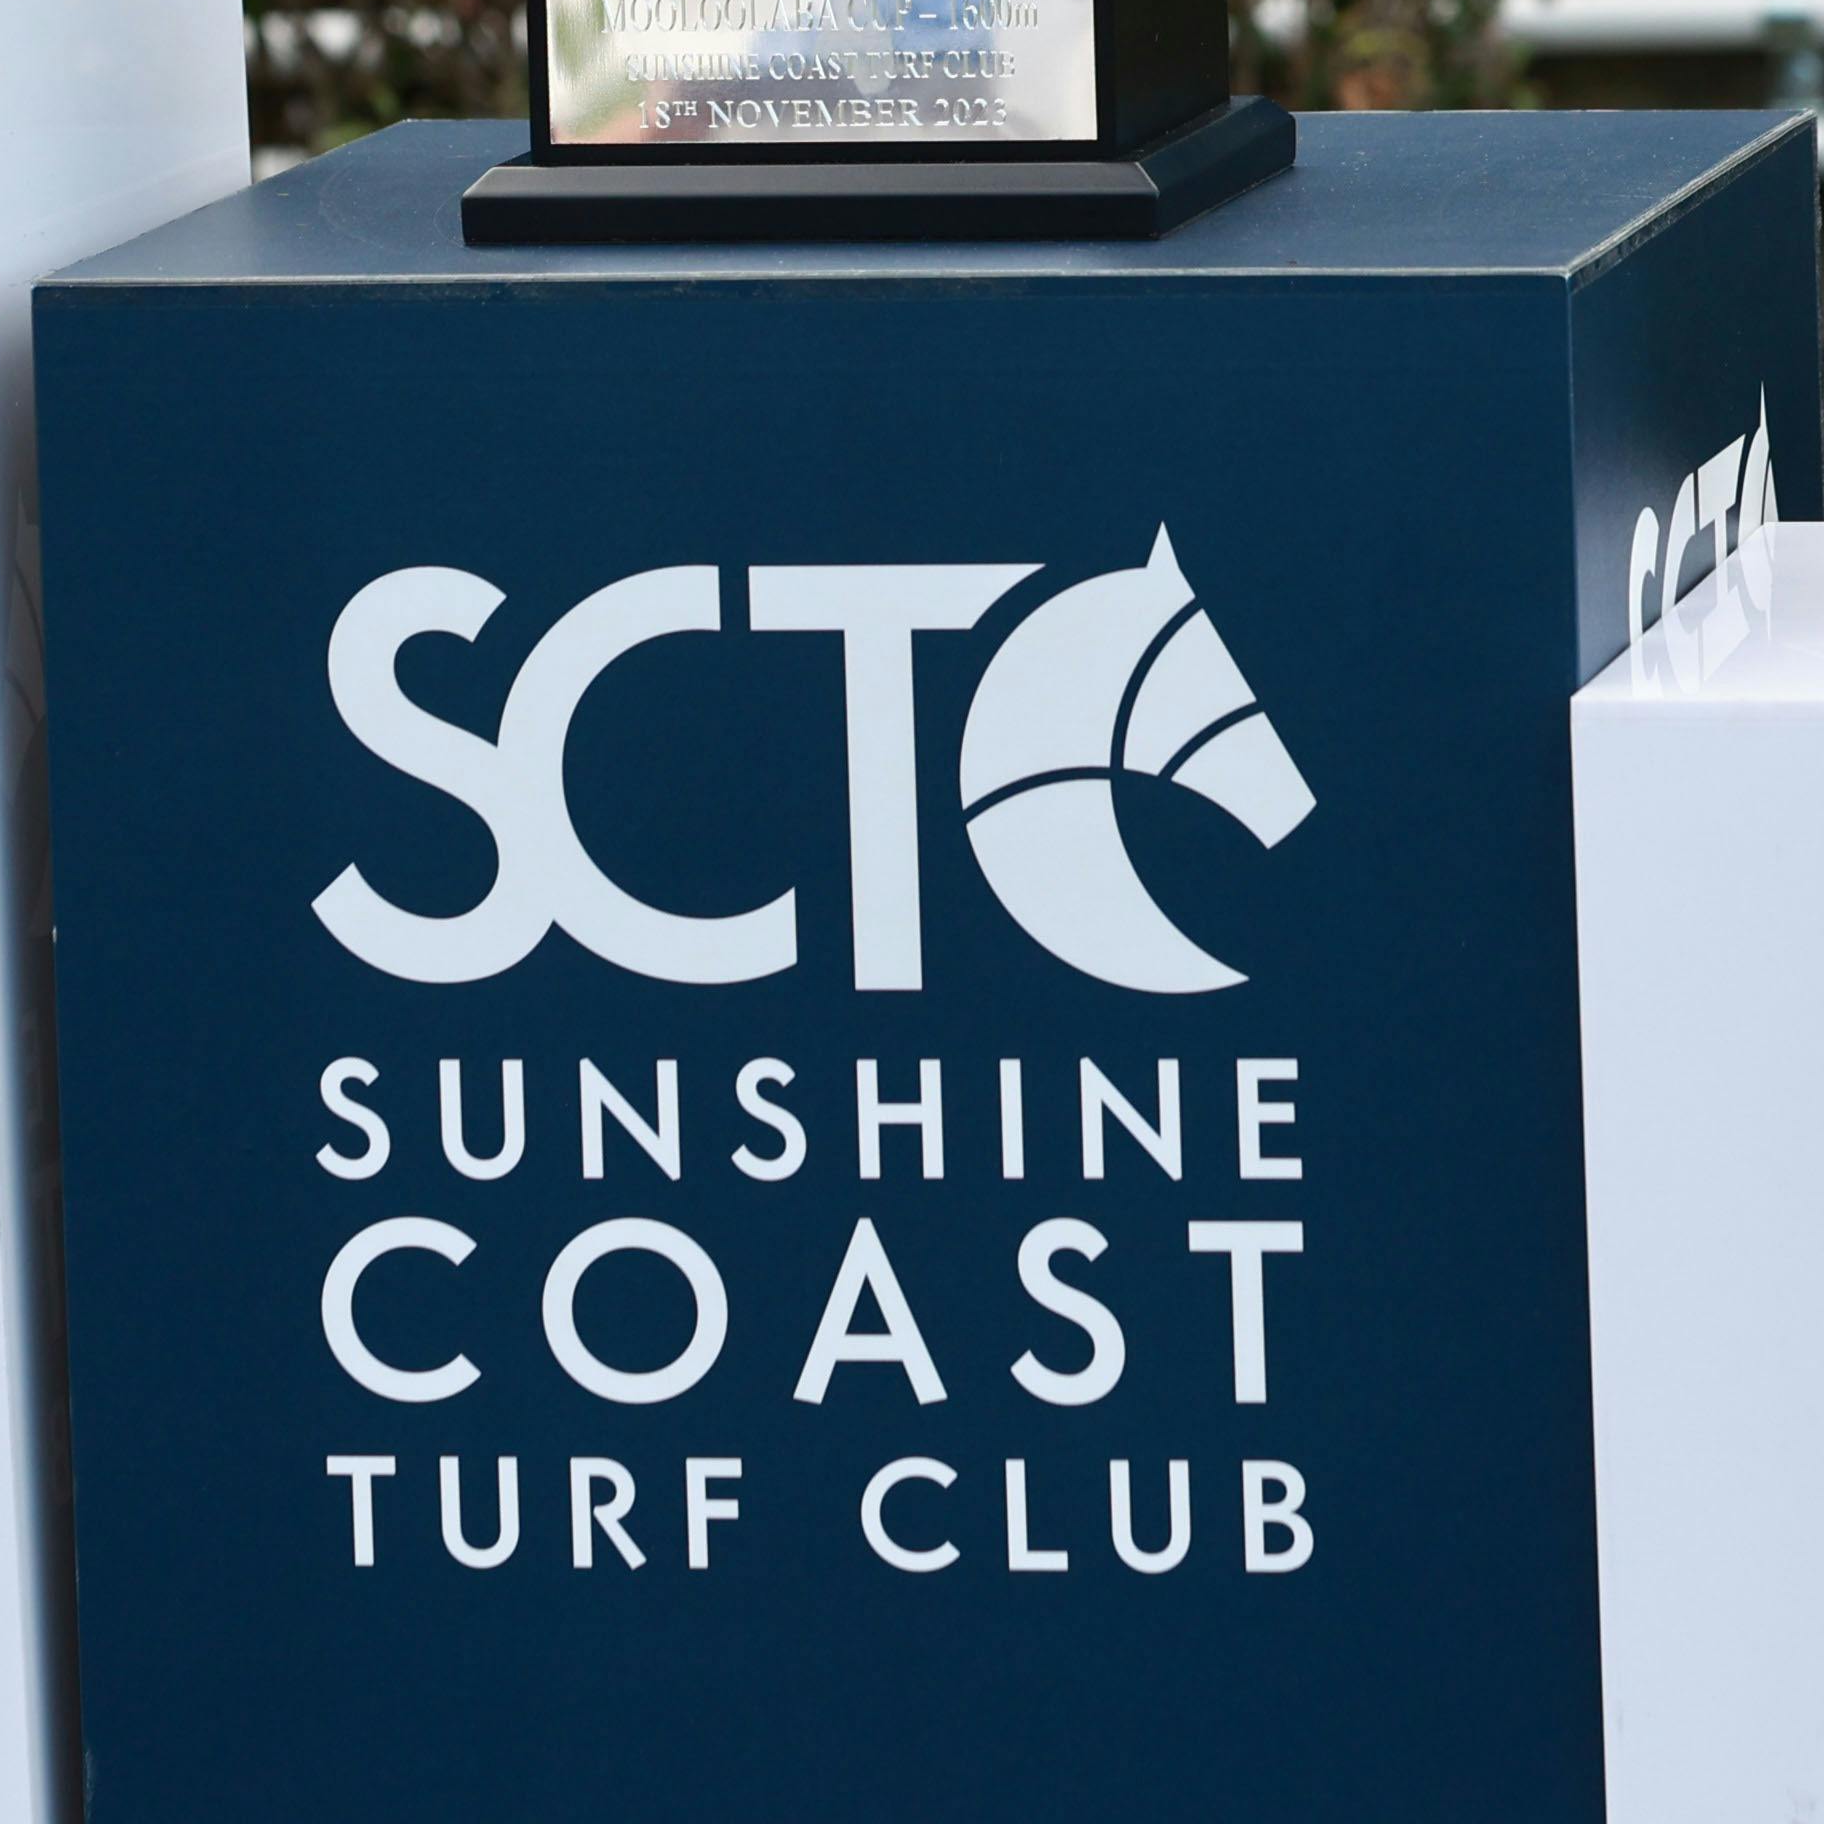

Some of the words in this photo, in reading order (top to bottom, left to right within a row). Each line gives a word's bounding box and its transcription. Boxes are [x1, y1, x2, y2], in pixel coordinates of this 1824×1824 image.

[625, 52, 760, 81] SUNSHINE
[769, 52, 856, 81] COAST
[865, 51, 937, 79] TURF
[942, 50, 1016, 78] CLUB
[708, 98, 923, 129] NOVEMBER
[935, 97, 1008, 127] 2023
[315, 1056, 1304, 1182] SUNSHINE
[321, 1215, 1304, 1406] COAST
[326, 1455, 743, 1571] TURF
[860, 1456, 1315, 1574] CLUB
